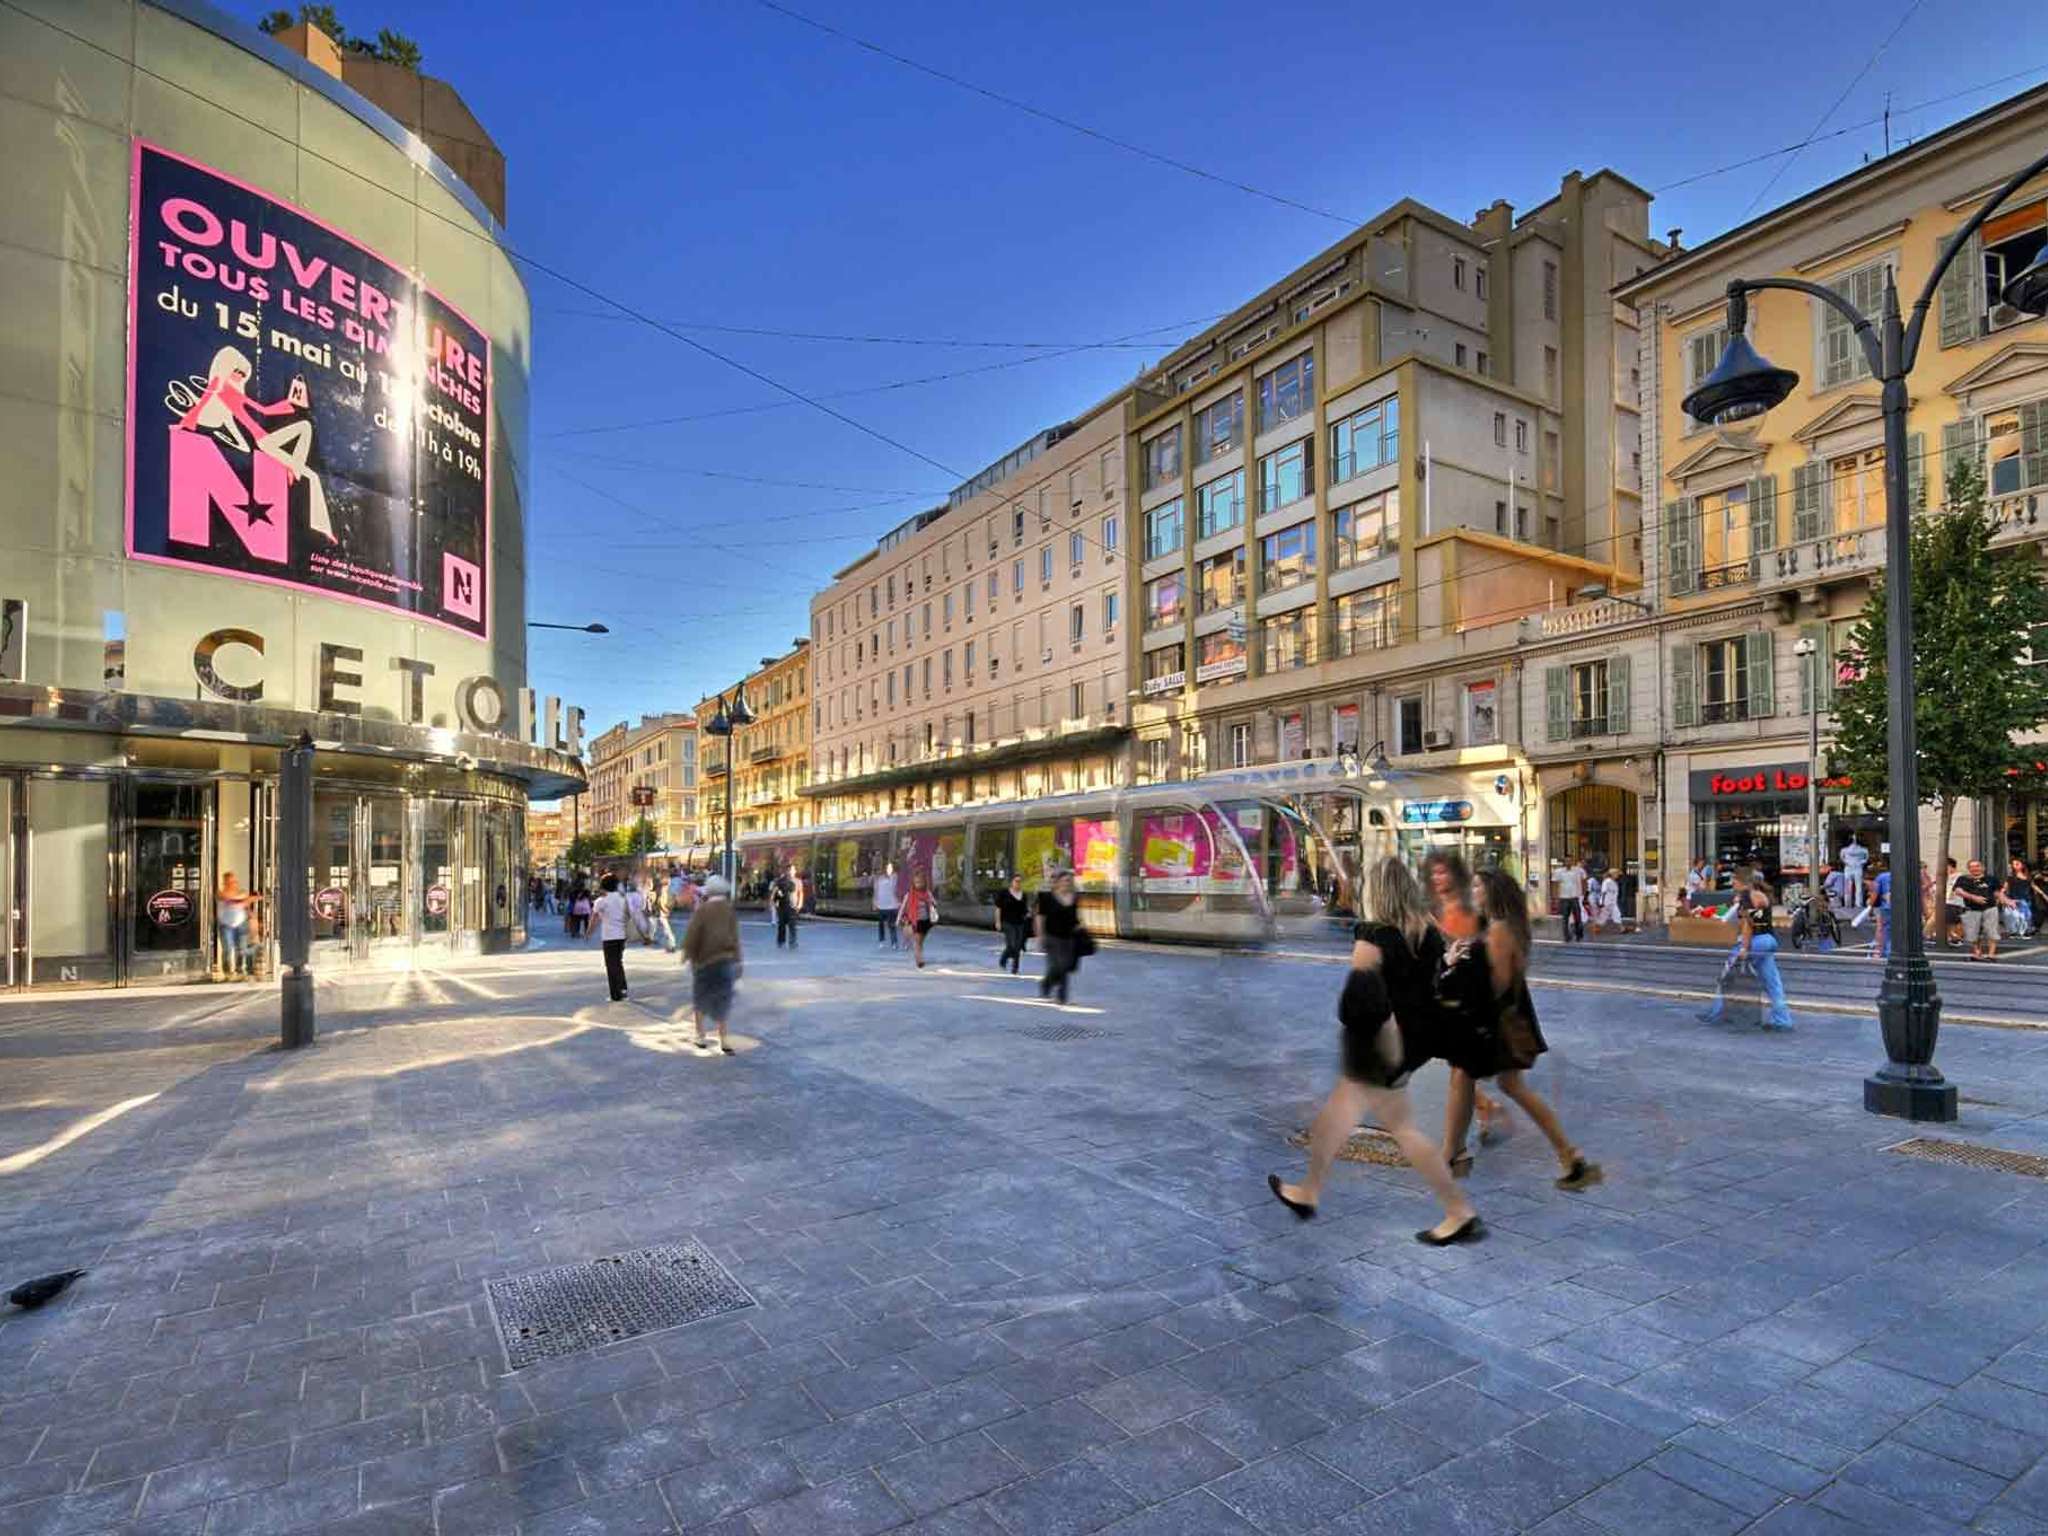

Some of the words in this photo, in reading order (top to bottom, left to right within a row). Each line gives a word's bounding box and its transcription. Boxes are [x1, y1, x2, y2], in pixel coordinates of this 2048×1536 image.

[157, 241, 270, 301] TOUS
[282, 289, 335, 331] LES
[156, 284, 199, 318] du
[215, 302, 260, 339] 15
[270, 328, 332, 369] mai
[339, 359, 368, 386] au
[442, 442, 453, 463] à
[458, 449, 481, 481] 19h
[1710, 773, 1767, 797] Foot
